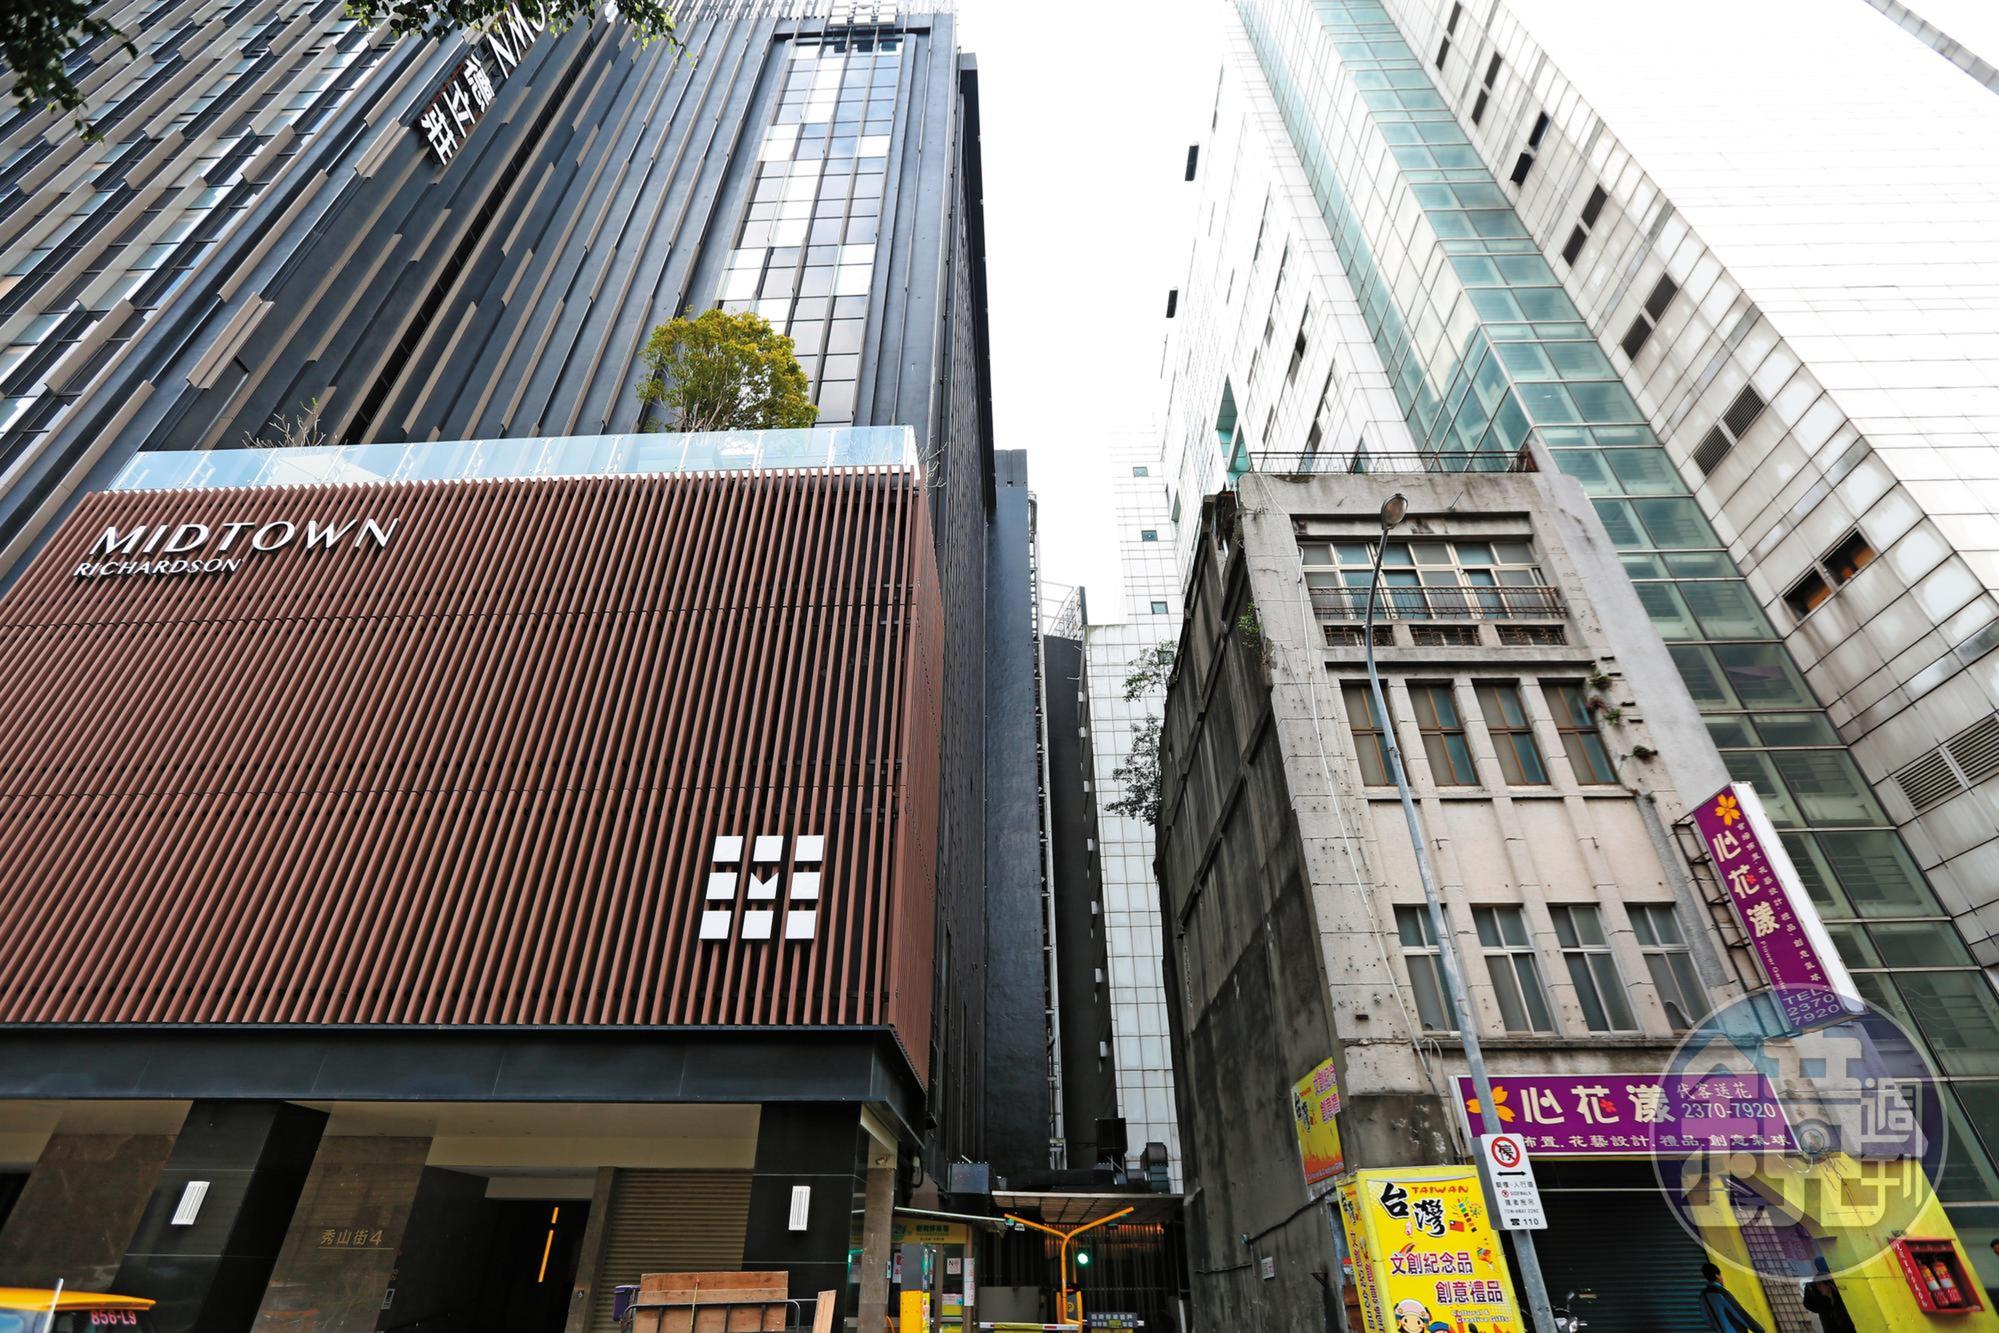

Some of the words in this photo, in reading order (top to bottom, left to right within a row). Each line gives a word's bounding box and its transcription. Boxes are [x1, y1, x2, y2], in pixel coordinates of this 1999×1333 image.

[420, 53, 496, 166] 德立莊
[89, 518, 399, 555] MIDTOWN
[73, 558, 242, 577] RICHARDSON
[1712, 829, 1780, 938] 心花漾
[1787, 993, 1835, 1017] 2370
[1791, 1004, 1840, 1026] 7920
[1676, 1081, 1753, 1099] 代客送花
[1520, 1084, 1676, 1125] 心花漾
[1681, 1102, 1777, 1119] 2370-7920
[1412, 1186, 1469, 1194] TAIWAN
[1380, 1182, 1446, 1237] 台灣
[1524, 1218, 1539, 1226] 110
[1390, 1252, 1474, 1276] 文創紀念品
[1434, 1280, 1504, 1303] 創意禮品
